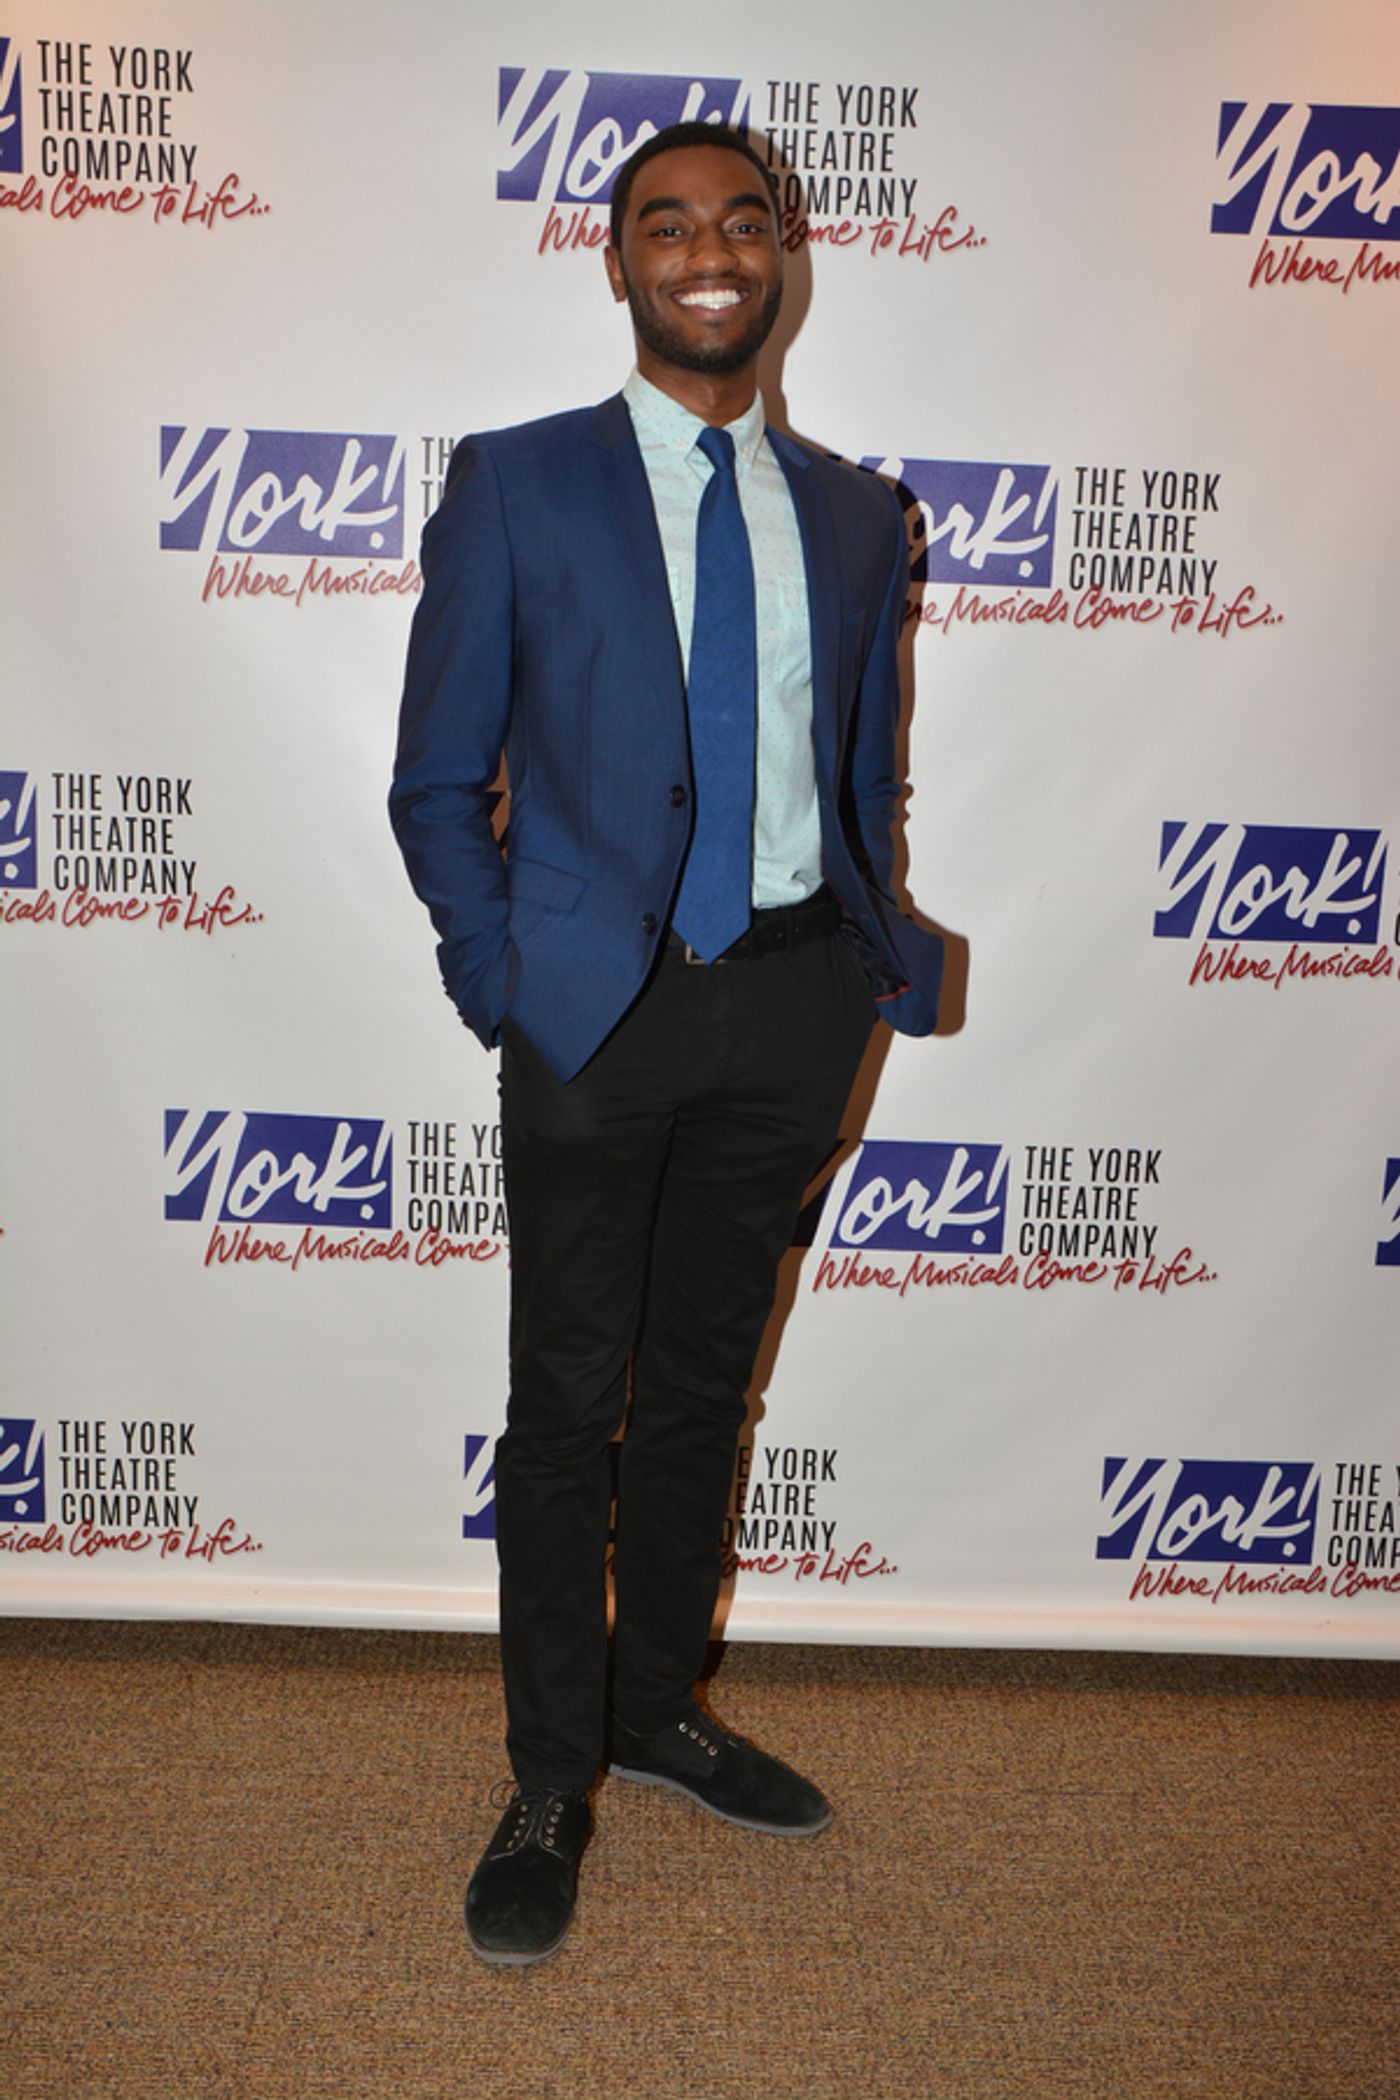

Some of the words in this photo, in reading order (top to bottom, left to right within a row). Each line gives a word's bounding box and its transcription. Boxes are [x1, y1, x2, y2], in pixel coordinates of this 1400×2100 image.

[37, 40, 93, 86] THE
[109, 46, 194, 92] YORK
[38, 88, 172, 137] THEATRE
[767, 81, 820, 124] THE
[837, 84, 919, 128] YORK
[41, 135, 198, 184] COMPANY
[765, 128, 895, 172] THEATRE
[51, 170, 144, 219] Come
[150, 183, 180, 224] to
[538, 206, 612, 255] Wher
[869, 217, 899, 257] to
[1249, 239, 1345, 288] Where
[421, 436, 454, 475] TH
[160, 425, 405, 556] York!
[1075, 467, 1126, 507] THE
[1143, 470, 1221, 512] YORK
[1072, 510, 1197, 553] THEATRE
[203, 555, 296, 602] Where
[295, 558, 422, 607] Musicals
[1069, 553, 1218, 597] COMPANY
[942, 586, 1069, 635] Musicals
[1073, 583, 1164, 629] Come
[1169, 595, 1199, 634] to
[52, 773, 102, 811] THE
[116, 775, 193, 815] YORK
[52, 814, 174, 854] THEATRE
[54, 855, 196, 896] COMPANY
[1154, 821, 1387, 940] York!
[62, 882, 149, 928] Come
[155, 895, 183, 931] to
[1189, 942, 1276, 986] Where
[1274, 943, 1394, 990] Musicals
[408, 1122, 456, 1158] THE
[472, 1124, 503, 1159] YO
[164, 1109, 392, 1222] York!
[1025, 1146, 1074, 1181] THE
[1089, 1148, 1163, 1184] YORK
[408, 1197, 508, 1236] COMPA
[1022, 1185, 1140, 1221] THEATRE
[204, 1224, 292, 1267] Where
[292, 1227, 409, 1271] Musicals
[415, 1225, 500, 1266] Come
[1019, 1223, 1158, 1259] COMPANY
[812, 1250, 901, 1292] Where
[899, 1253, 1019, 1297] Musicals
[1023, 1249, 1108, 1290] Come
[1114, 1258, 1140, 1291] to
[58, 1421, 106, 1453] THE
[121, 1421, 195, 1456] YORK
[59, 1457, 176, 1491] THEATRE
[765, 1447, 839, 1482] YORK
[1336, 1463, 1382, 1497] THE
[61, 1493, 199, 1527] COMPANY
[736, 1482, 817, 1516] EATRE
[1097, 1456, 1321, 1560] York!
[1332, 1499, 1400, 1533] THEA
[70, 1519, 153, 1557] Come
[158, 1527, 184, 1558] to
[721, 1517, 837, 1552] OMPANY
[793, 1551, 820, 1582] to
[1129, 1563, 1214, 1601] Where
[1211, 1564, 1328, 1604] Musicals
